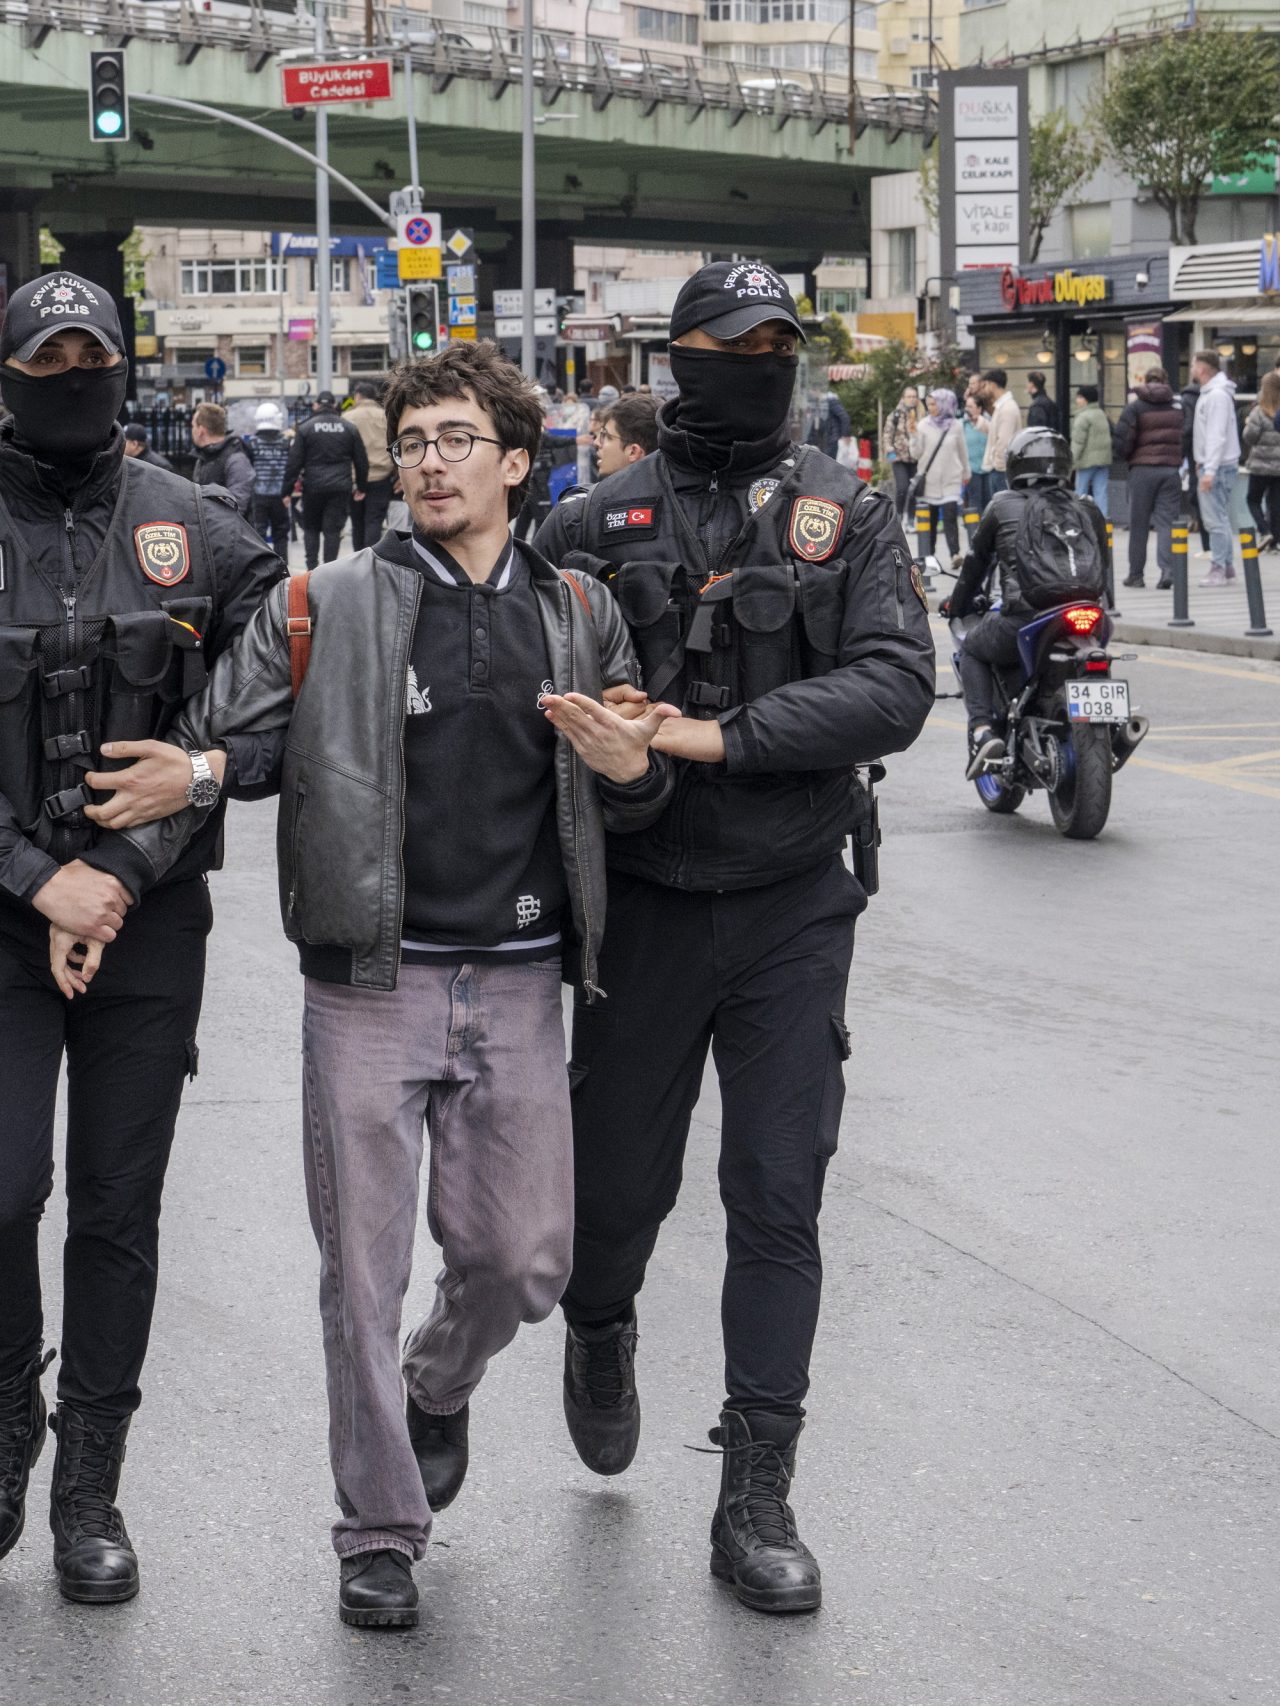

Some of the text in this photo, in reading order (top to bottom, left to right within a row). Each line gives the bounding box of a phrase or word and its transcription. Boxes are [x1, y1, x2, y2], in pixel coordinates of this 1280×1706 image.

[310, 82, 365, 98] Caddesi
[984, 156, 1009, 166] KALE
[60, 277, 99, 306] KUVVET
[40, 304, 90, 318] POLİS
[606, 511, 628, 522] ÖZEL
[607, 519, 626, 529] TİM
[144, 531, 177, 540] ÖZEL TİM
[1070, 685, 1125, 700] 34 GIR
[1083, 701, 1113, 716] 038
